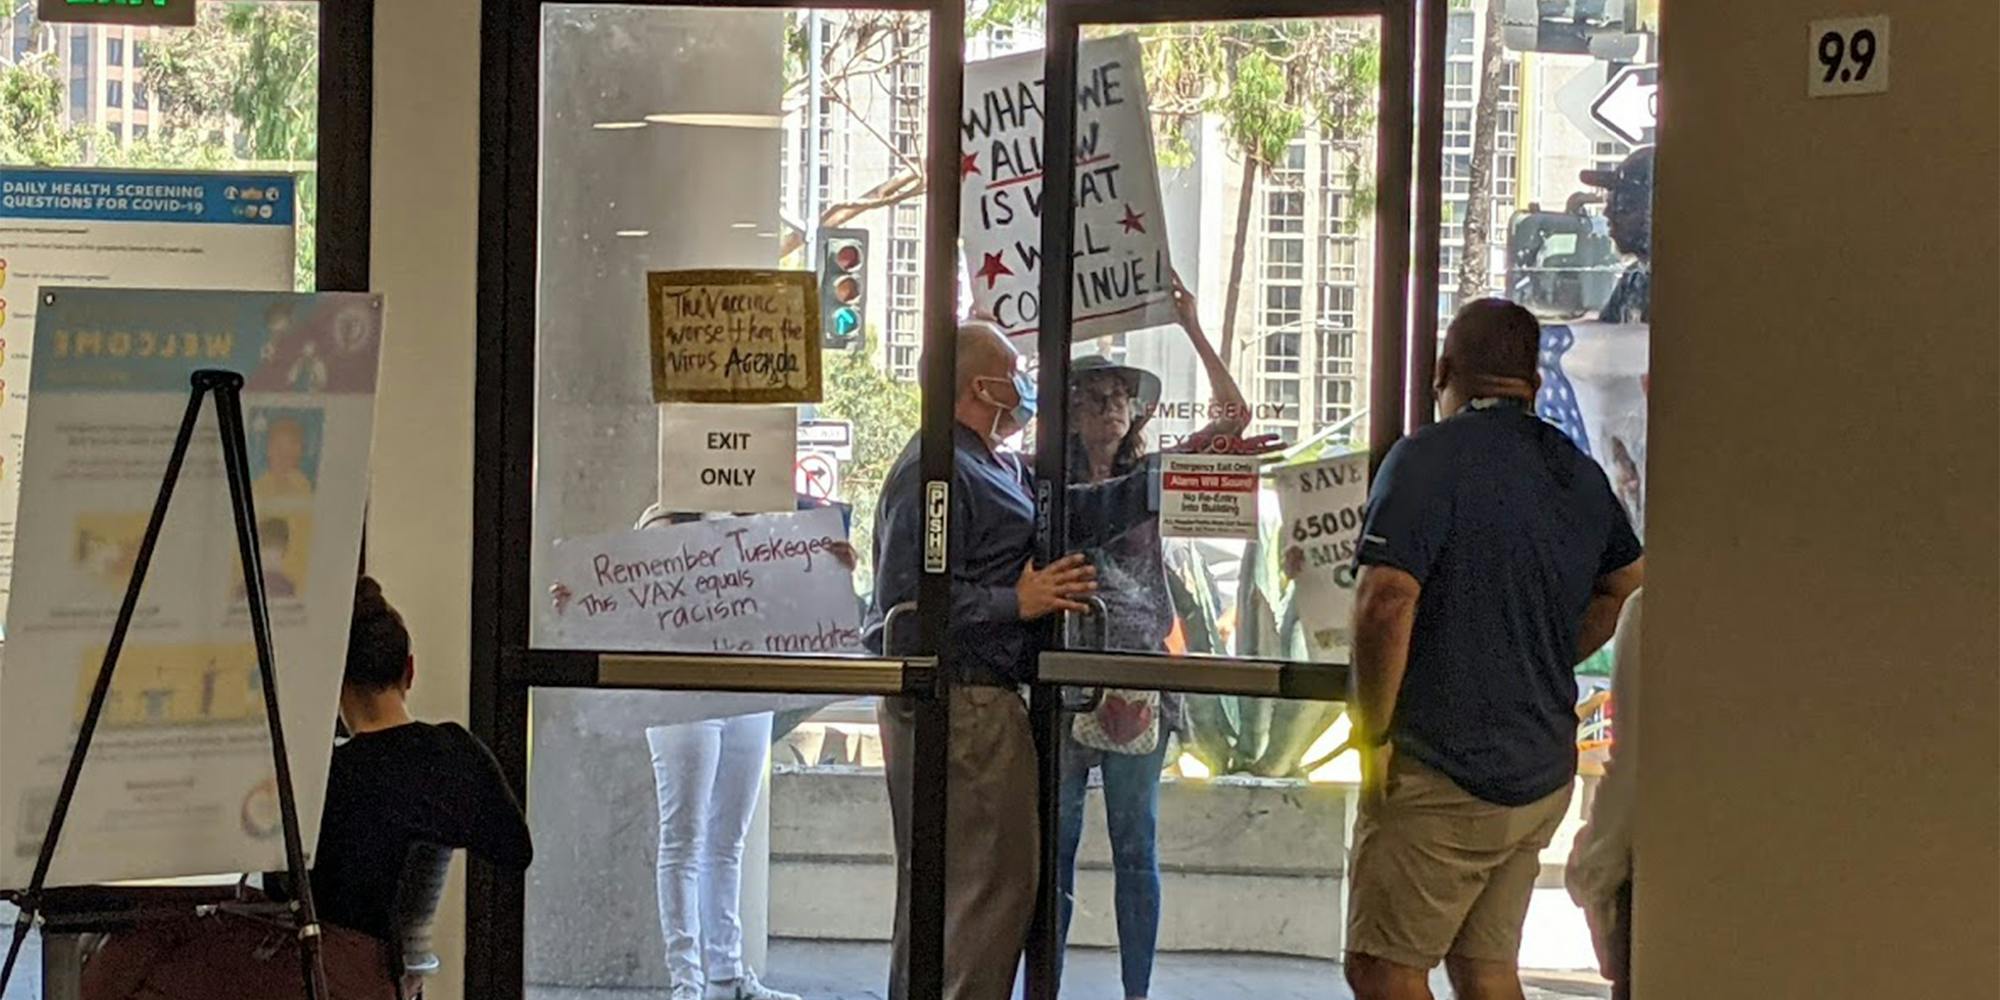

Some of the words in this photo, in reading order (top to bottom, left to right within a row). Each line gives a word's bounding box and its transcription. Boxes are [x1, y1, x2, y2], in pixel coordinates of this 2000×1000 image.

[1818, 28, 1876, 83] 9.9
[960, 80, 1046, 142] WHA
[3, 182, 47, 194] DAILY
[51, 183, 111, 195] HEALTH
[116, 184, 204, 198] SCREENING
[3, 195, 93, 209] QUESTIONS
[96, 197, 128, 210] FOR
[132, 198, 204, 215] COVID-19
[980, 190, 1014, 230] IS
[993, 249, 1163, 328] COINUE!
[666, 323, 725, 345] worse
[780, 317, 803, 341] the
[1145, 402, 1286, 420] EMERGENCY
[707, 432, 751, 450] EXIT
[701, 468, 756, 486] ONLY
[1170, 461, 1215, 471] Emergency
[1217, 462, 1232, 471] Exit
[1300, 462, 1362, 493] SAVE
[1170, 475, 1200, 487] Alarm
[1200, 475, 1220, 487] Will
[1220, 476, 1252, 488] Sound
[1183, 492, 1196, 502] No
[1201, 503, 1239, 516] Building
[929, 489, 943, 548] PUSH
[1036, 488, 1050, 543] PUSH
[594, 543, 722, 587] Remember
[726, 528, 833, 573] Tuskegee
[578, 594, 618, 617] This
[629, 577, 687, 609] VAX
[696, 568, 754, 598] equals
[658, 597, 758, 632] racism
